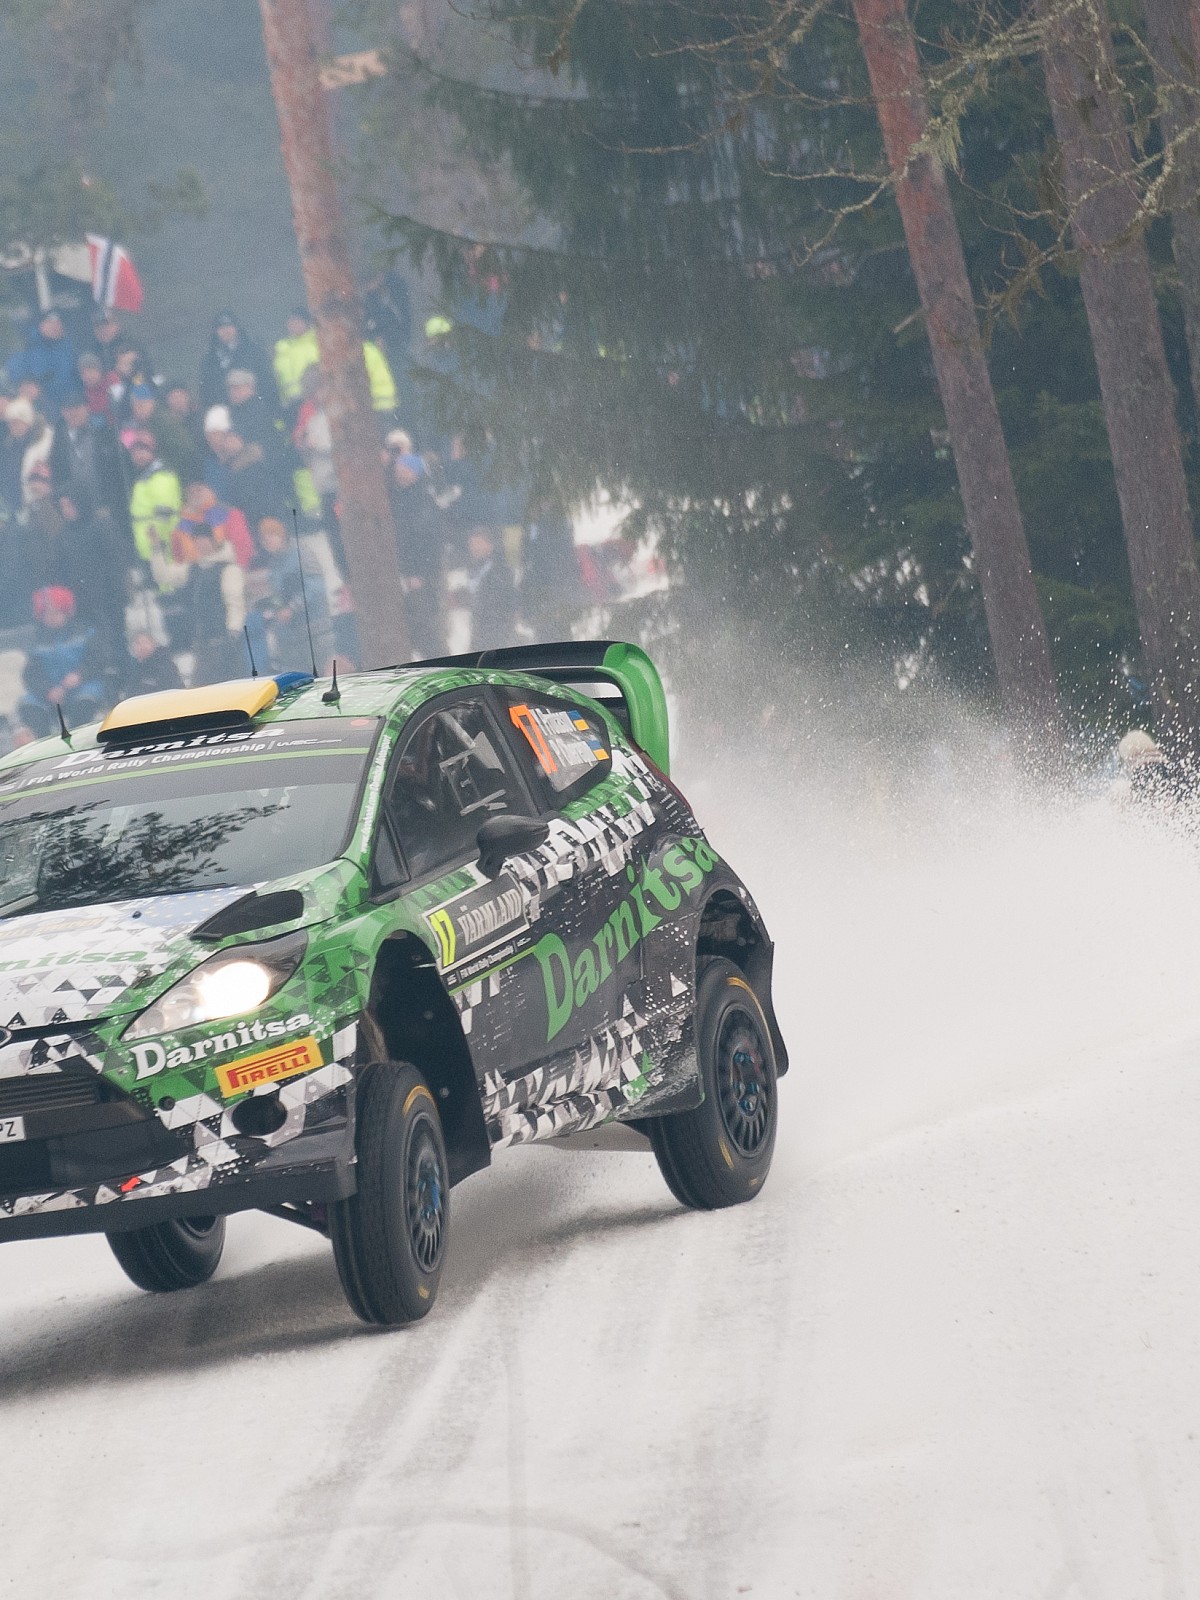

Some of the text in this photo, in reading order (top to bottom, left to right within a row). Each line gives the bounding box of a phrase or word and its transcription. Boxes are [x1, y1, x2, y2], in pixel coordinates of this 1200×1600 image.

[26, 773, 53, 787] FIA
[57, 766, 103, 780] World
[106, 758, 149, 772] Rally
[151, 741, 266, 765] Championship
[51, 727, 285, 770] Darnitsa
[428, 908, 456, 968] 17
[533, 836, 719, 1043] Darnitsa
[128, 1012, 314, 1081] Darnitsa
[226, 1045, 312, 1090] PIRELLI
